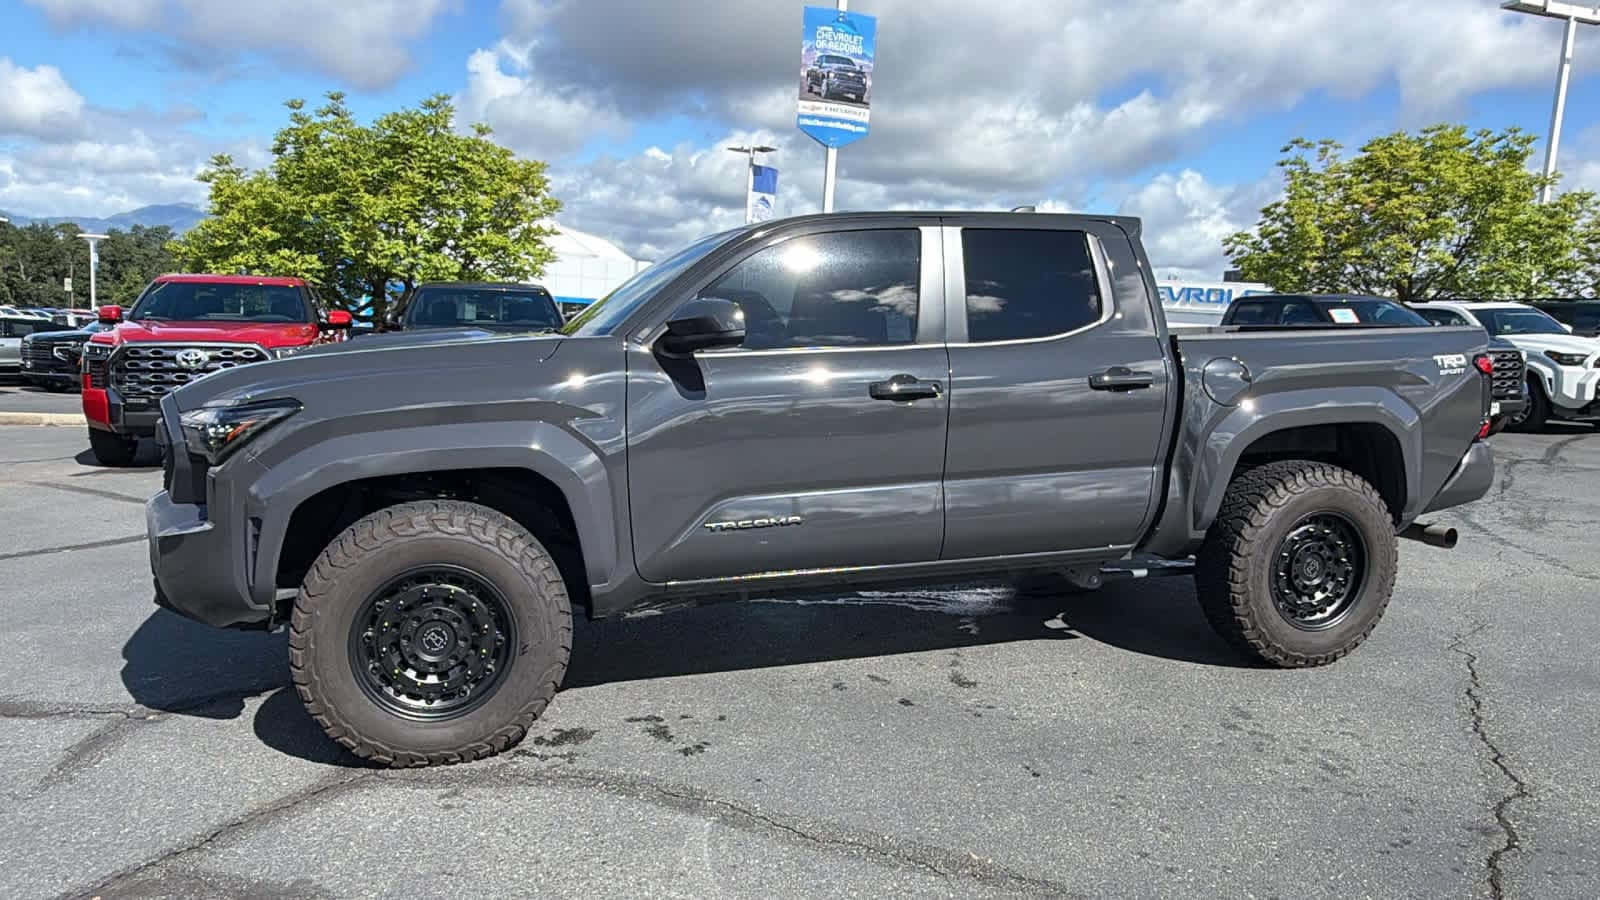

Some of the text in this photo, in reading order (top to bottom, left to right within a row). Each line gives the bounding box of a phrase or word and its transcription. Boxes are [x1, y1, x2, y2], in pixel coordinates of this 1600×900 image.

[816, 30, 864, 45] CHEVROLET
[815, 40, 863, 55] OF REDDING
[1432, 354, 1467, 368] TRD
[1440, 367, 1465, 376] SPORT
[704, 516, 801, 532] TACOMA
